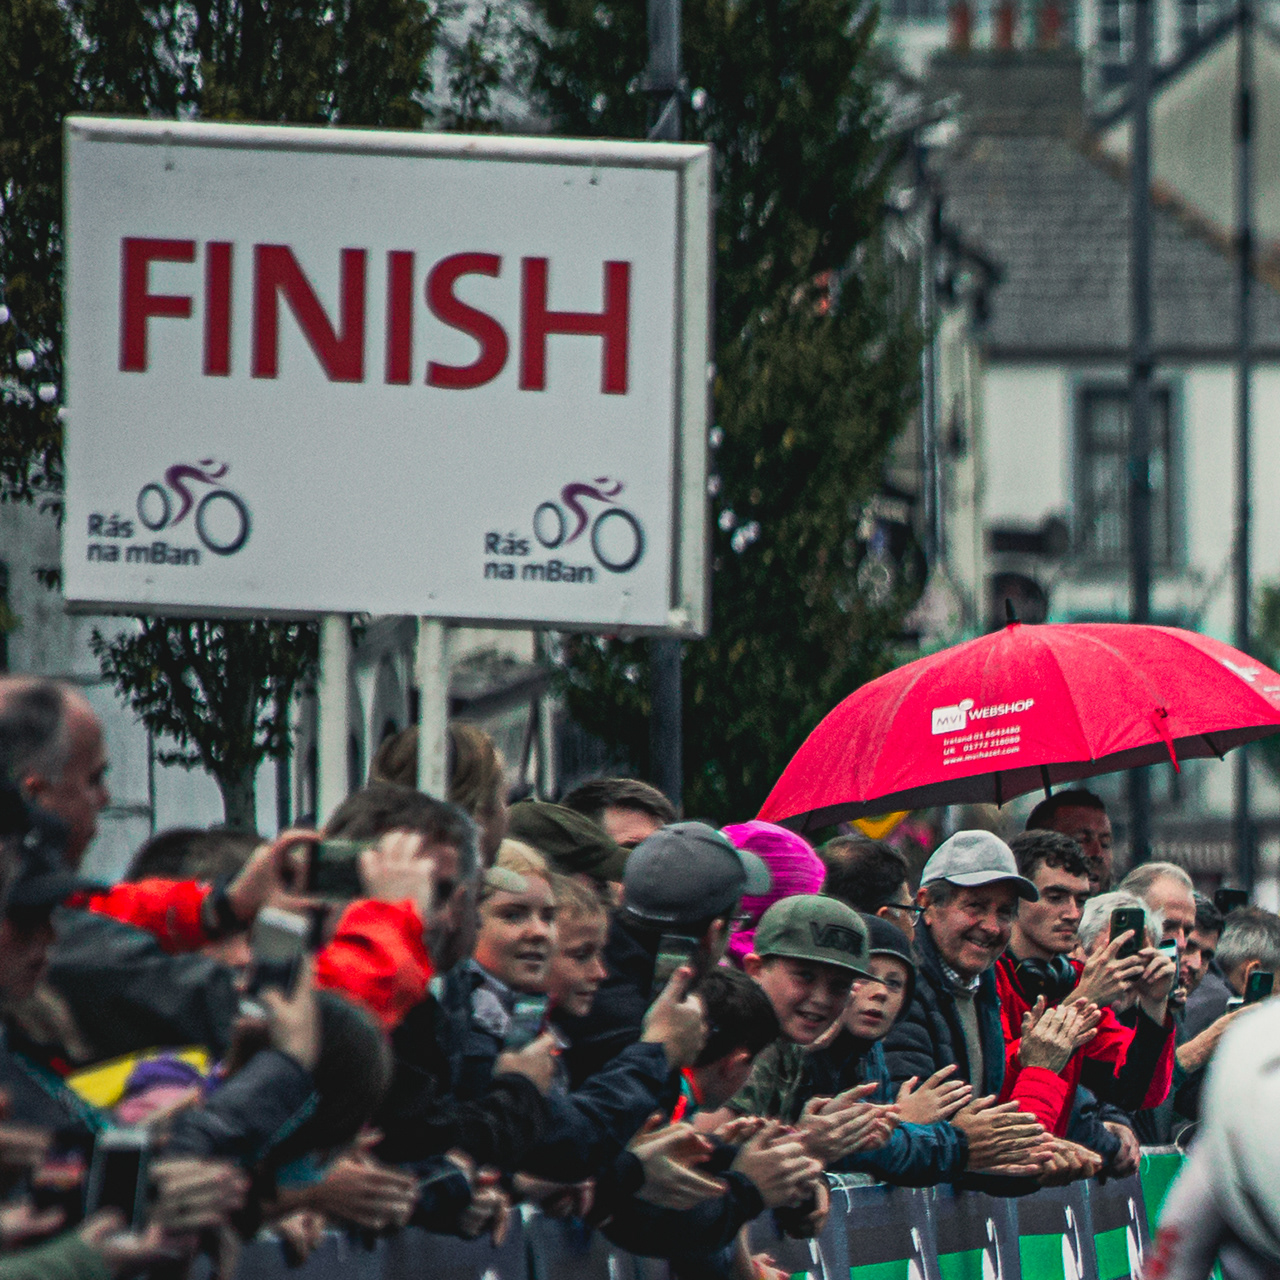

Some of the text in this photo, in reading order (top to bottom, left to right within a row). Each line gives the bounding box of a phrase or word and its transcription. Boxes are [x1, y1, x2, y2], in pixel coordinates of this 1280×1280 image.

[119, 236, 632, 396] FINISH
[86, 541, 201, 566] na mBan
[484, 559, 596, 584] na mBan
[936, 698, 1035, 727] MVI WEBSHOP
